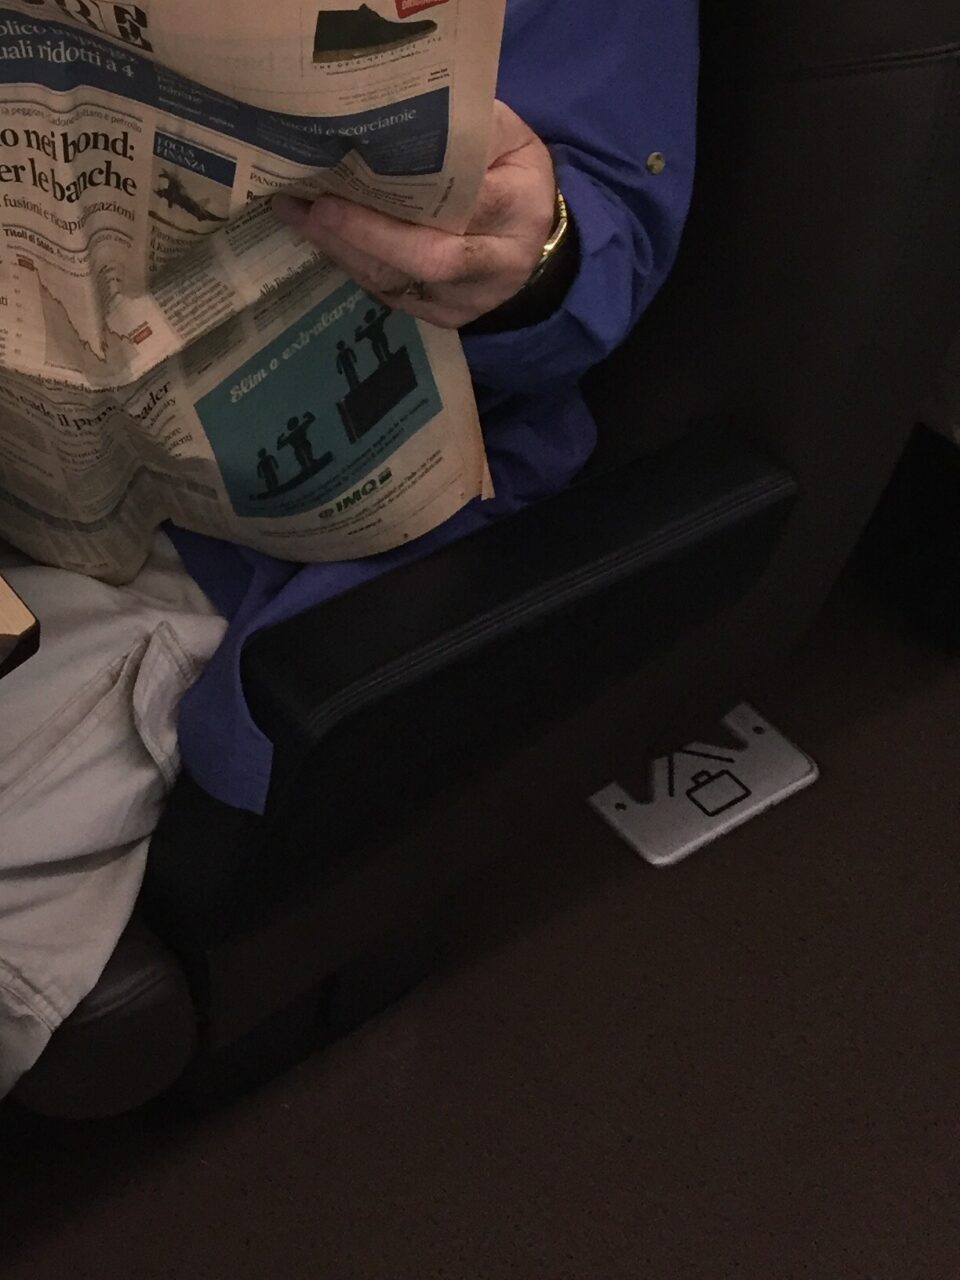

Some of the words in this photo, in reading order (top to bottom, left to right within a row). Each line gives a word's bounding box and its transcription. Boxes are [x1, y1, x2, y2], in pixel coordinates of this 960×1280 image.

[36, 40, 101, 66] ridotti
[24, 128, 57, 162] nei
[60, 130, 136, 163] bond:
[27, 160, 50, 193] le
[50, 161, 139, 204] banche
[2, 194, 42, 215] fusioni
